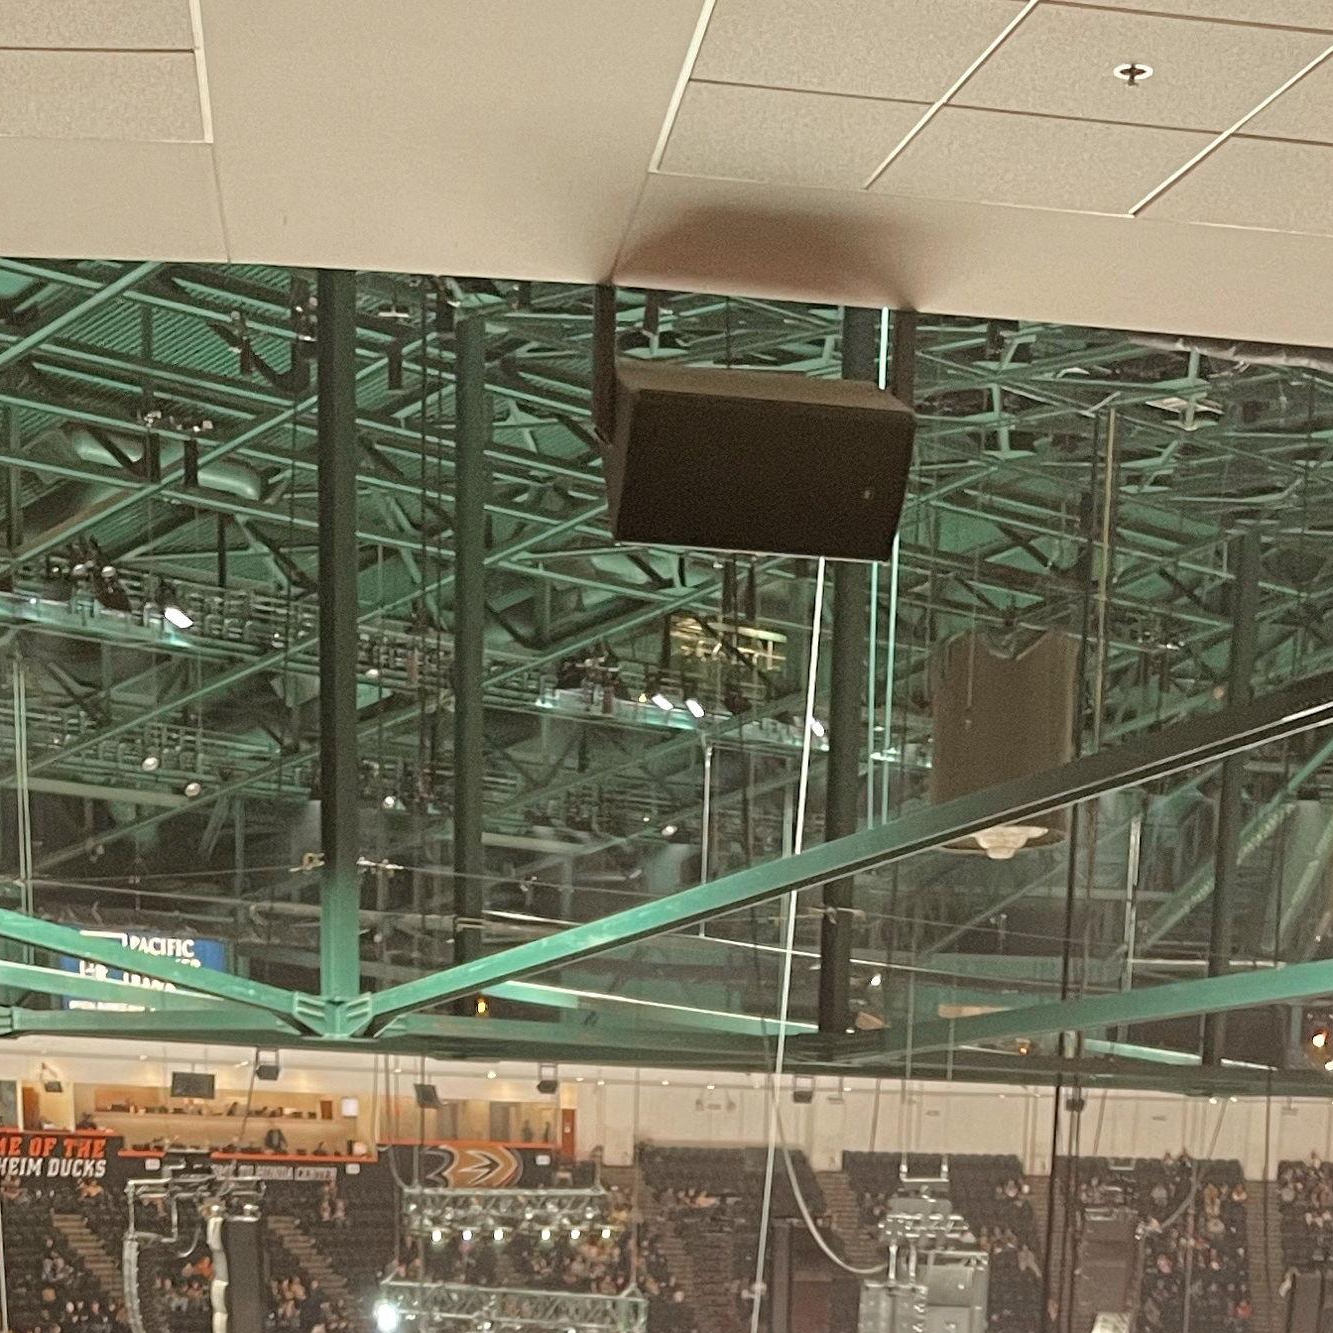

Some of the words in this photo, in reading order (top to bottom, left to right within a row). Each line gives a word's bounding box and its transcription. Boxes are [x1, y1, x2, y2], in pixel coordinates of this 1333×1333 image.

[28, 1137, 57, 1158] OF
[64, 1137, 107, 1159] THE
[47, 1158, 107, 1178] DUCKS
